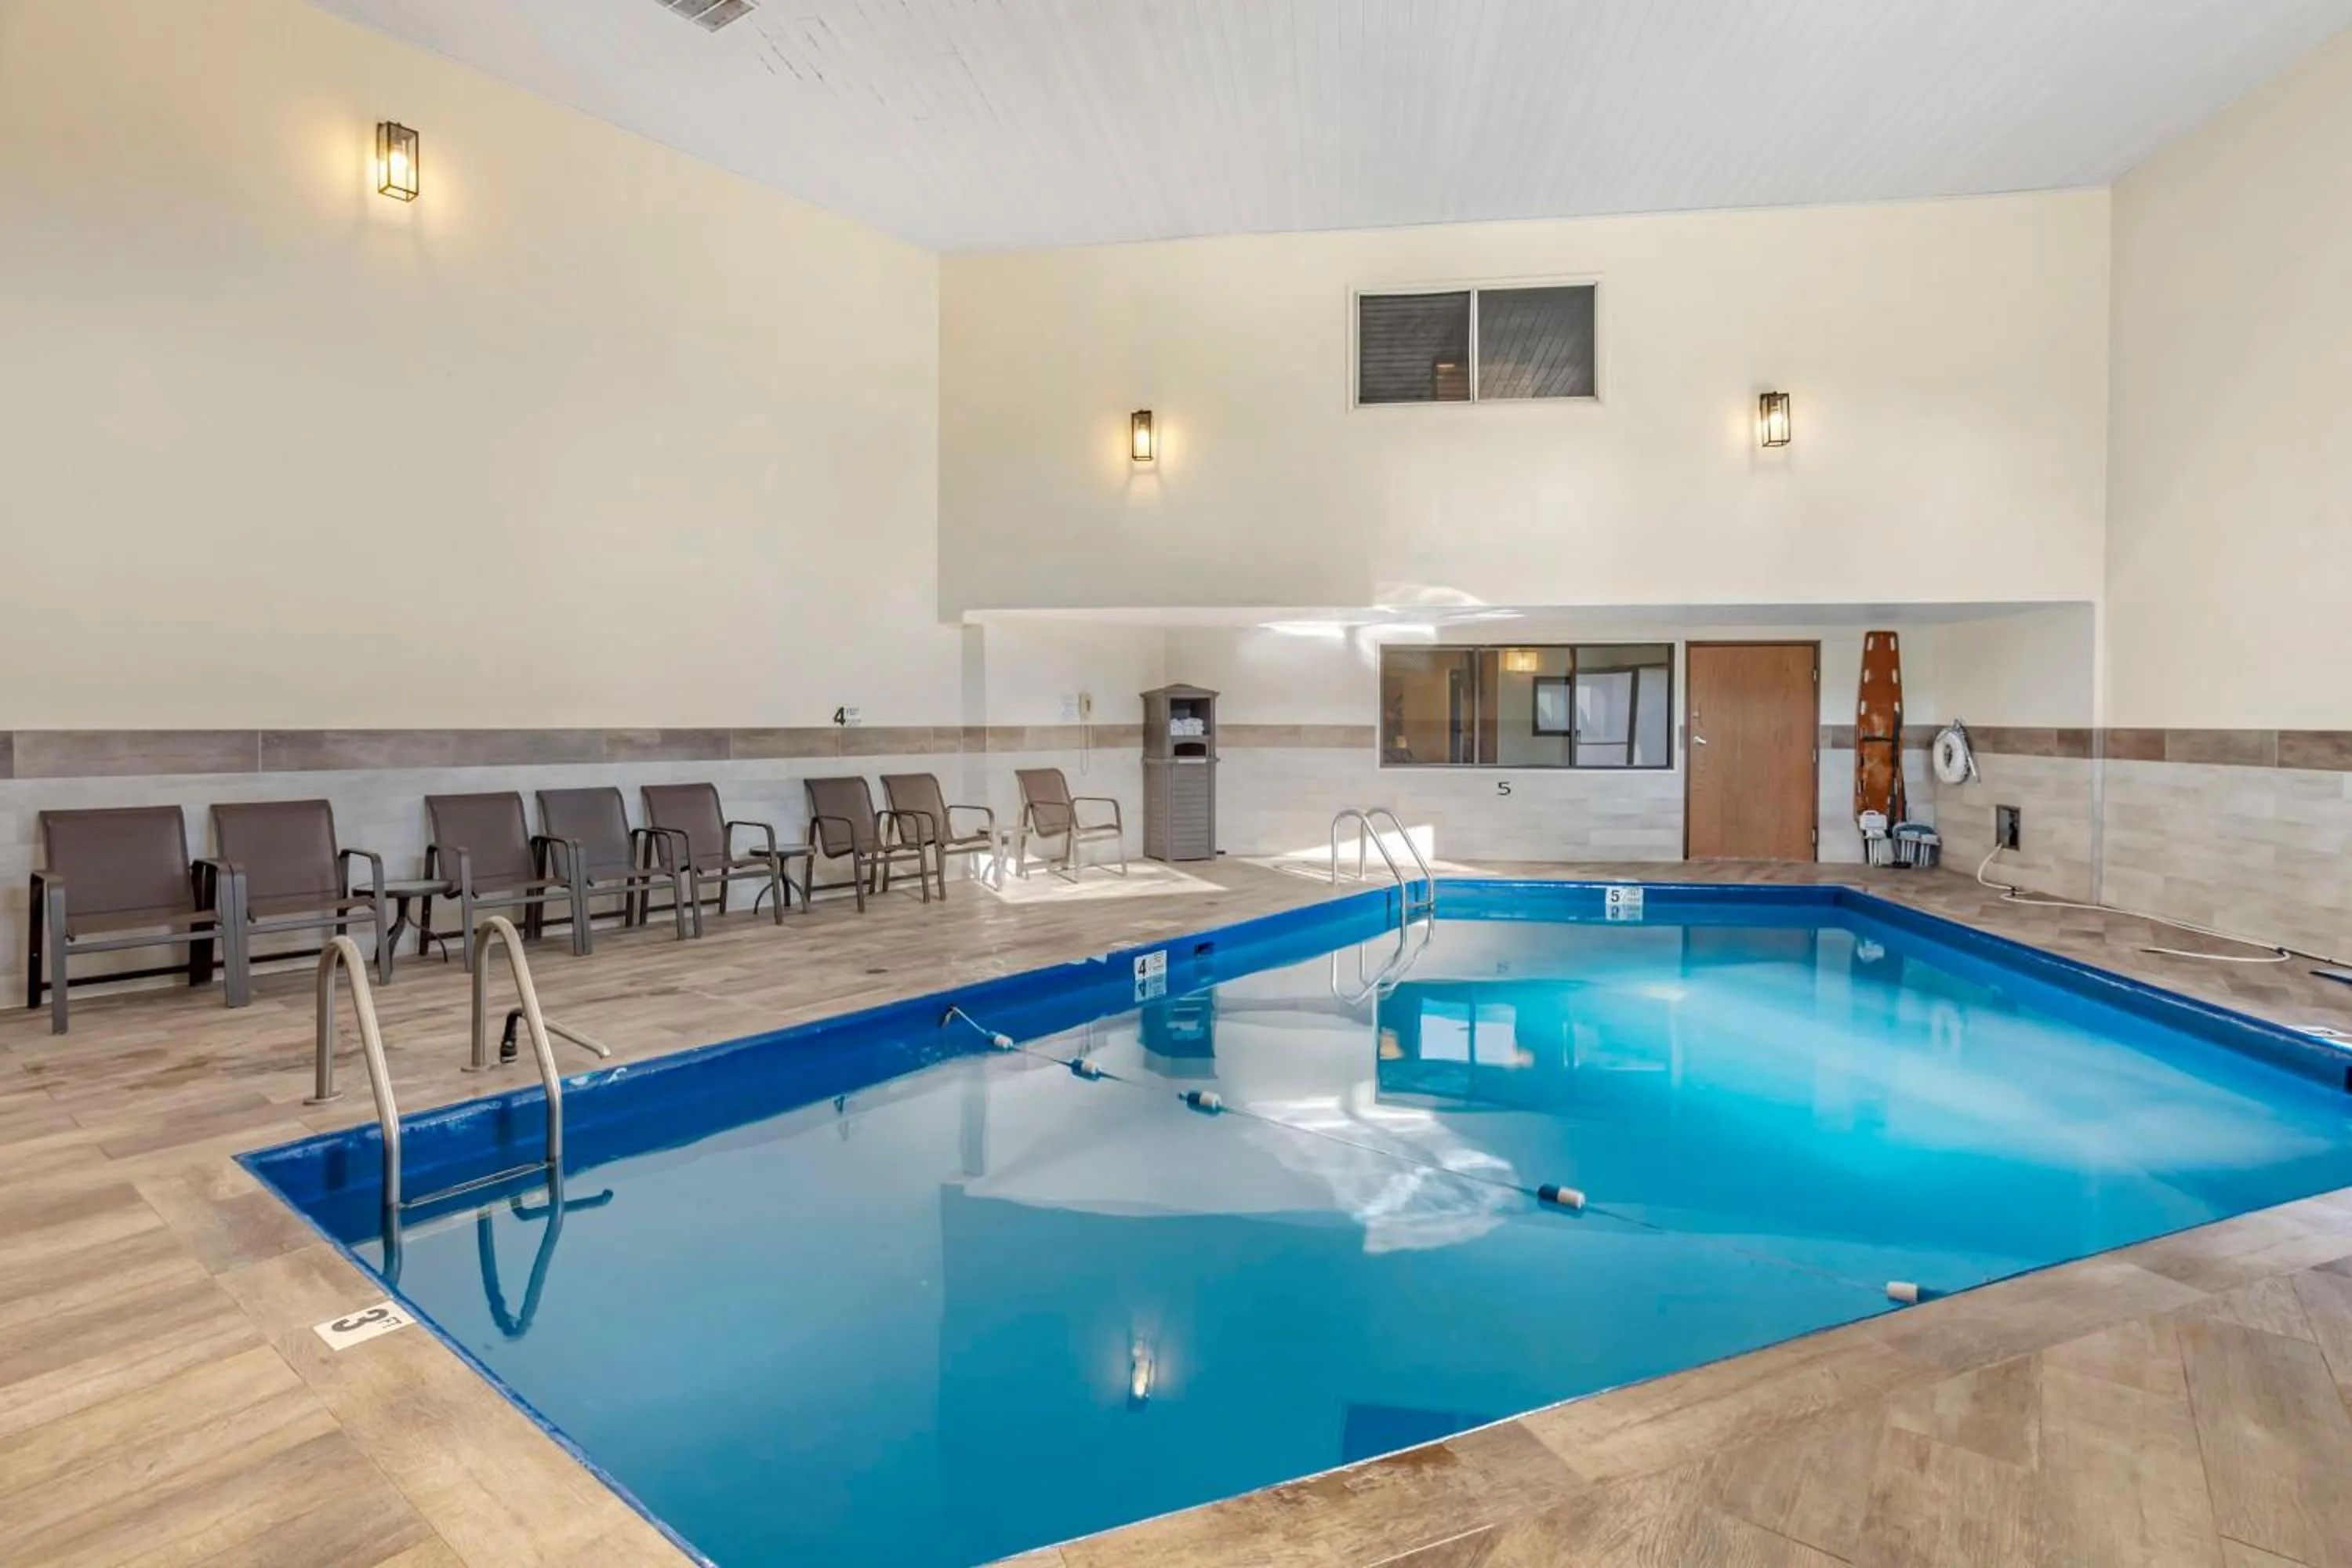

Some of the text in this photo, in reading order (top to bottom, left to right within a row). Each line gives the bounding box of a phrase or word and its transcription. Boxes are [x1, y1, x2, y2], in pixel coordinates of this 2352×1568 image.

[833, 706, 846, 726] 4
[1497, 782, 1511, 796] 5
[1611, 890, 1620, 902] 5
[1138, 959, 1146, 977] 4
[332, 1309, 389, 1332] 3
